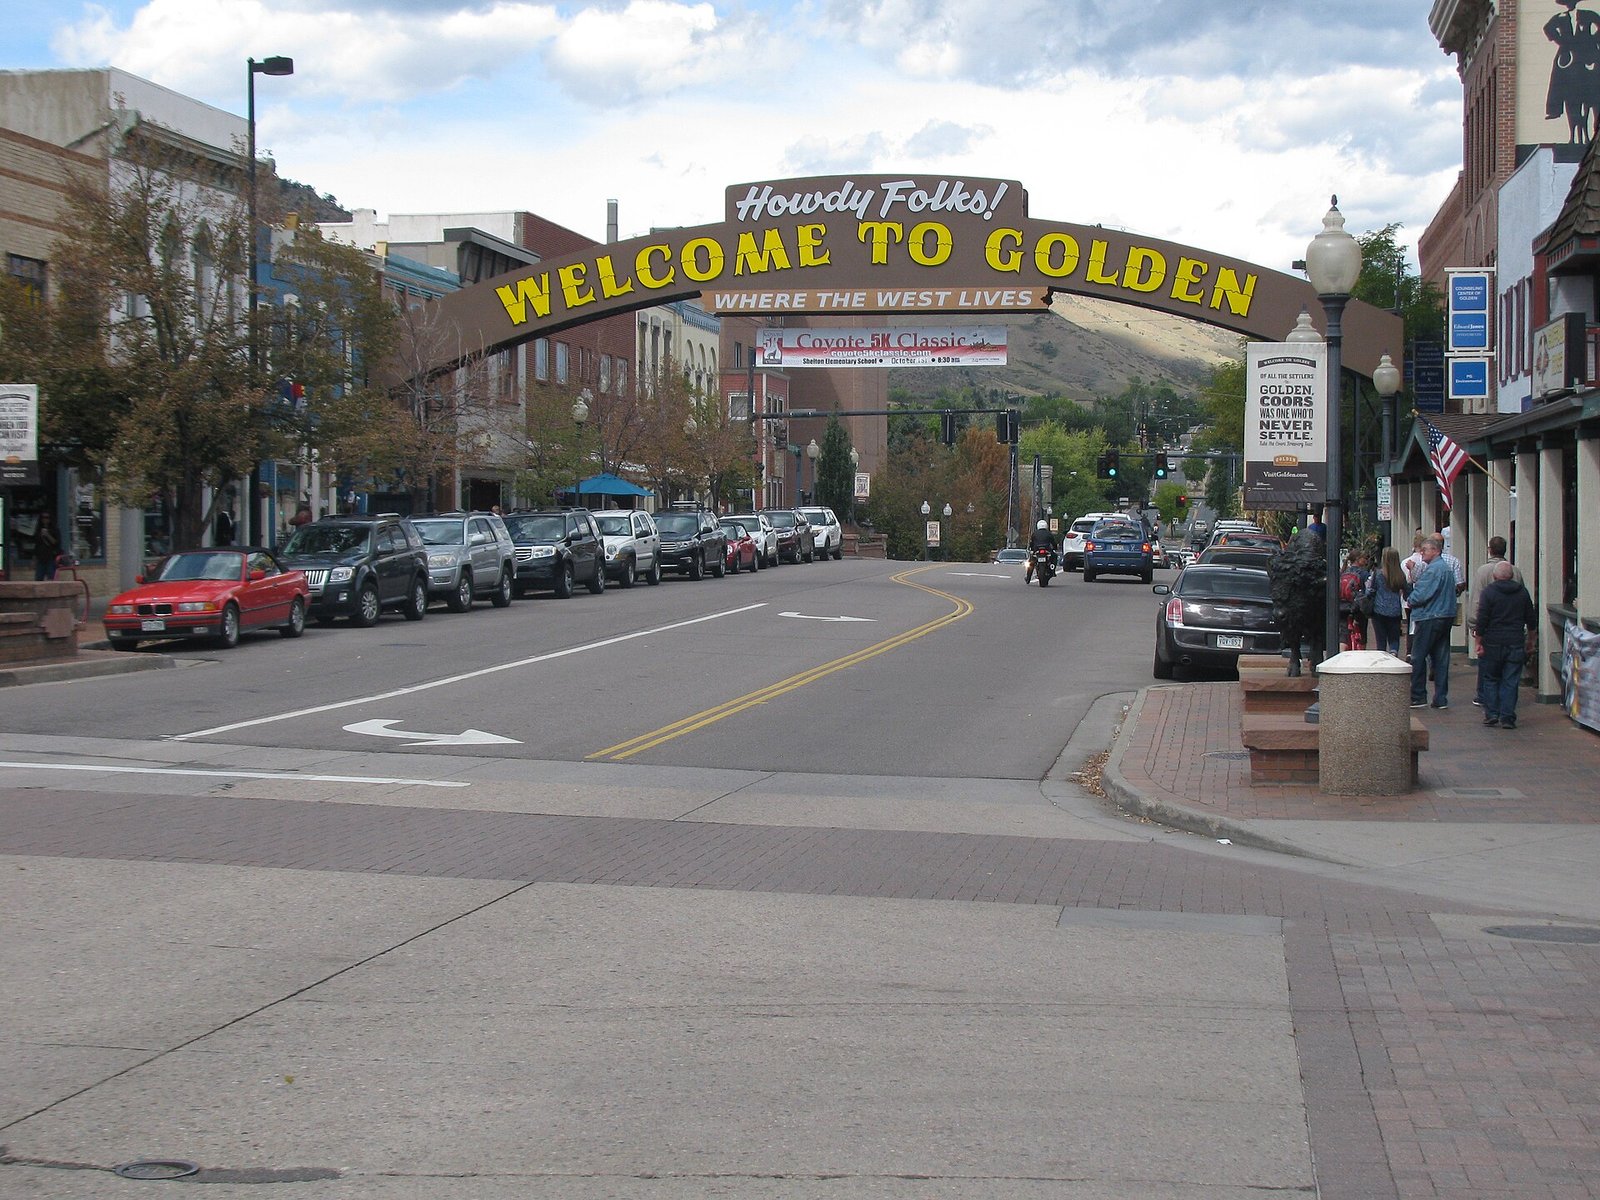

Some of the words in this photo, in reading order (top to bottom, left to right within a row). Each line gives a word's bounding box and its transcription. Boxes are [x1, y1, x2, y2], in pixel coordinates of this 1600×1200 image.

[736, 181, 875, 222] Howdy
[879, 180, 1009, 221] Folks!
[494, 222, 831, 326] WELCOME
[857, 221, 953, 267] TO
[984, 227, 1258, 317] GOLDEN
[715, 292, 807, 309] WHERE
[823, 292, 866, 308] THE
[877, 291, 951, 308] WEST
[958, 290, 1033, 307] LIVES
[797, 334, 865, 355] Coyote
[870, 333, 891, 348] 5K
[897, 332, 966, 348] Classic
[831, 349, 932, 358] coyote5kclassic.com
[857, 357, 877, 365] School
[1260, 396, 1314, 407] COORS
[1260, 408, 1275, 419] WAS
[1276, 408, 1290, 419] ONE
[1291, 408, 1314, 419] WHO'D
[1260, 420, 1313, 430] NEVER
[1260, 431, 1313, 440] SETTLE.
